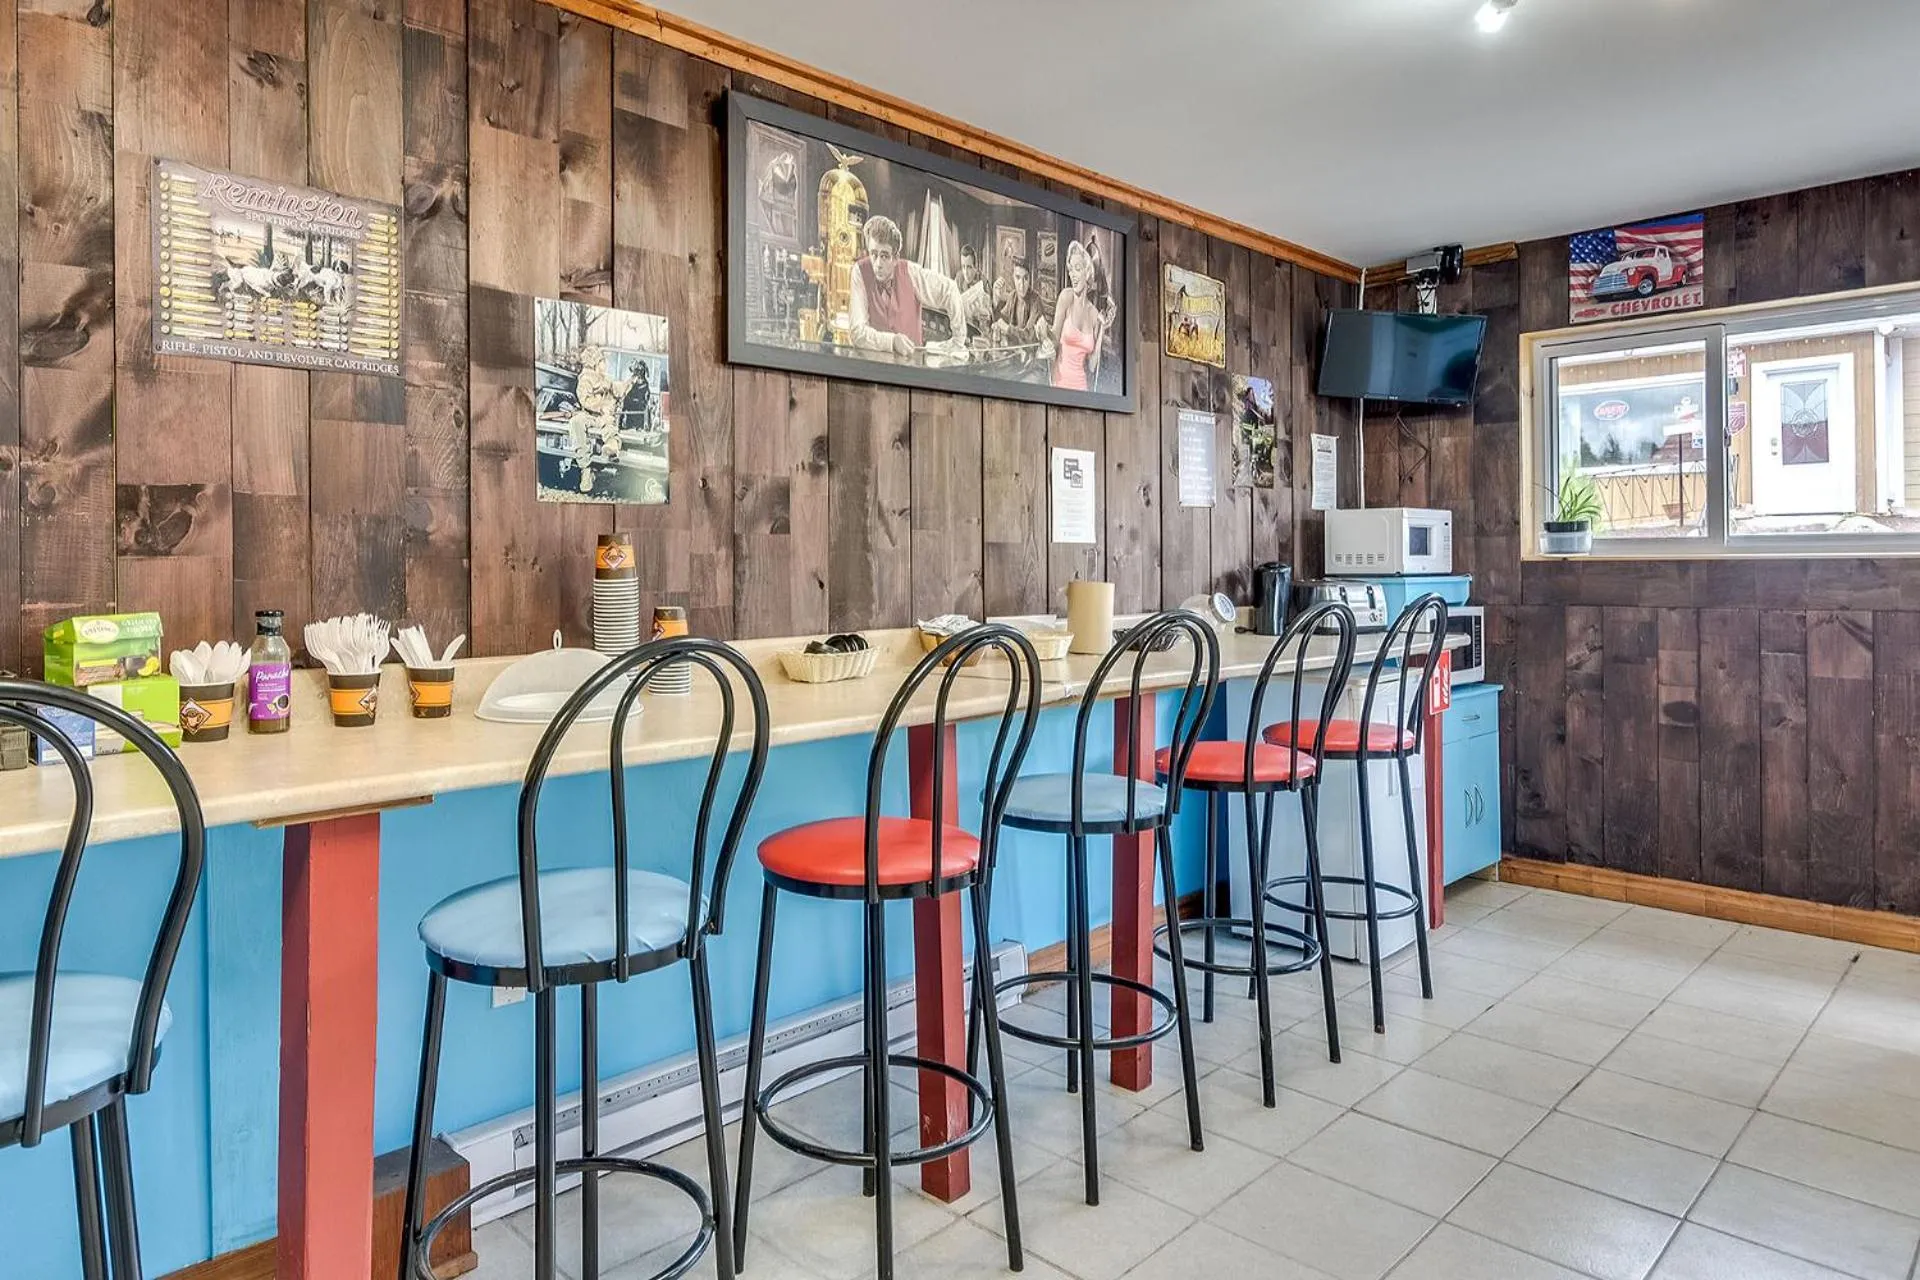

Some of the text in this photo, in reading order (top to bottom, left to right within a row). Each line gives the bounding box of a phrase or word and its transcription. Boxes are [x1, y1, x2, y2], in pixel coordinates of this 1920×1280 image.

[202, 173, 364, 230] Remington
[246, 212, 361, 240] SPORTING CARTRIDGES
[1610, 292, 1700, 316] CHEVROLET
[161, 340, 400, 375] RIFLE, PISTOL AND REVOLVER CARTRIDGES
